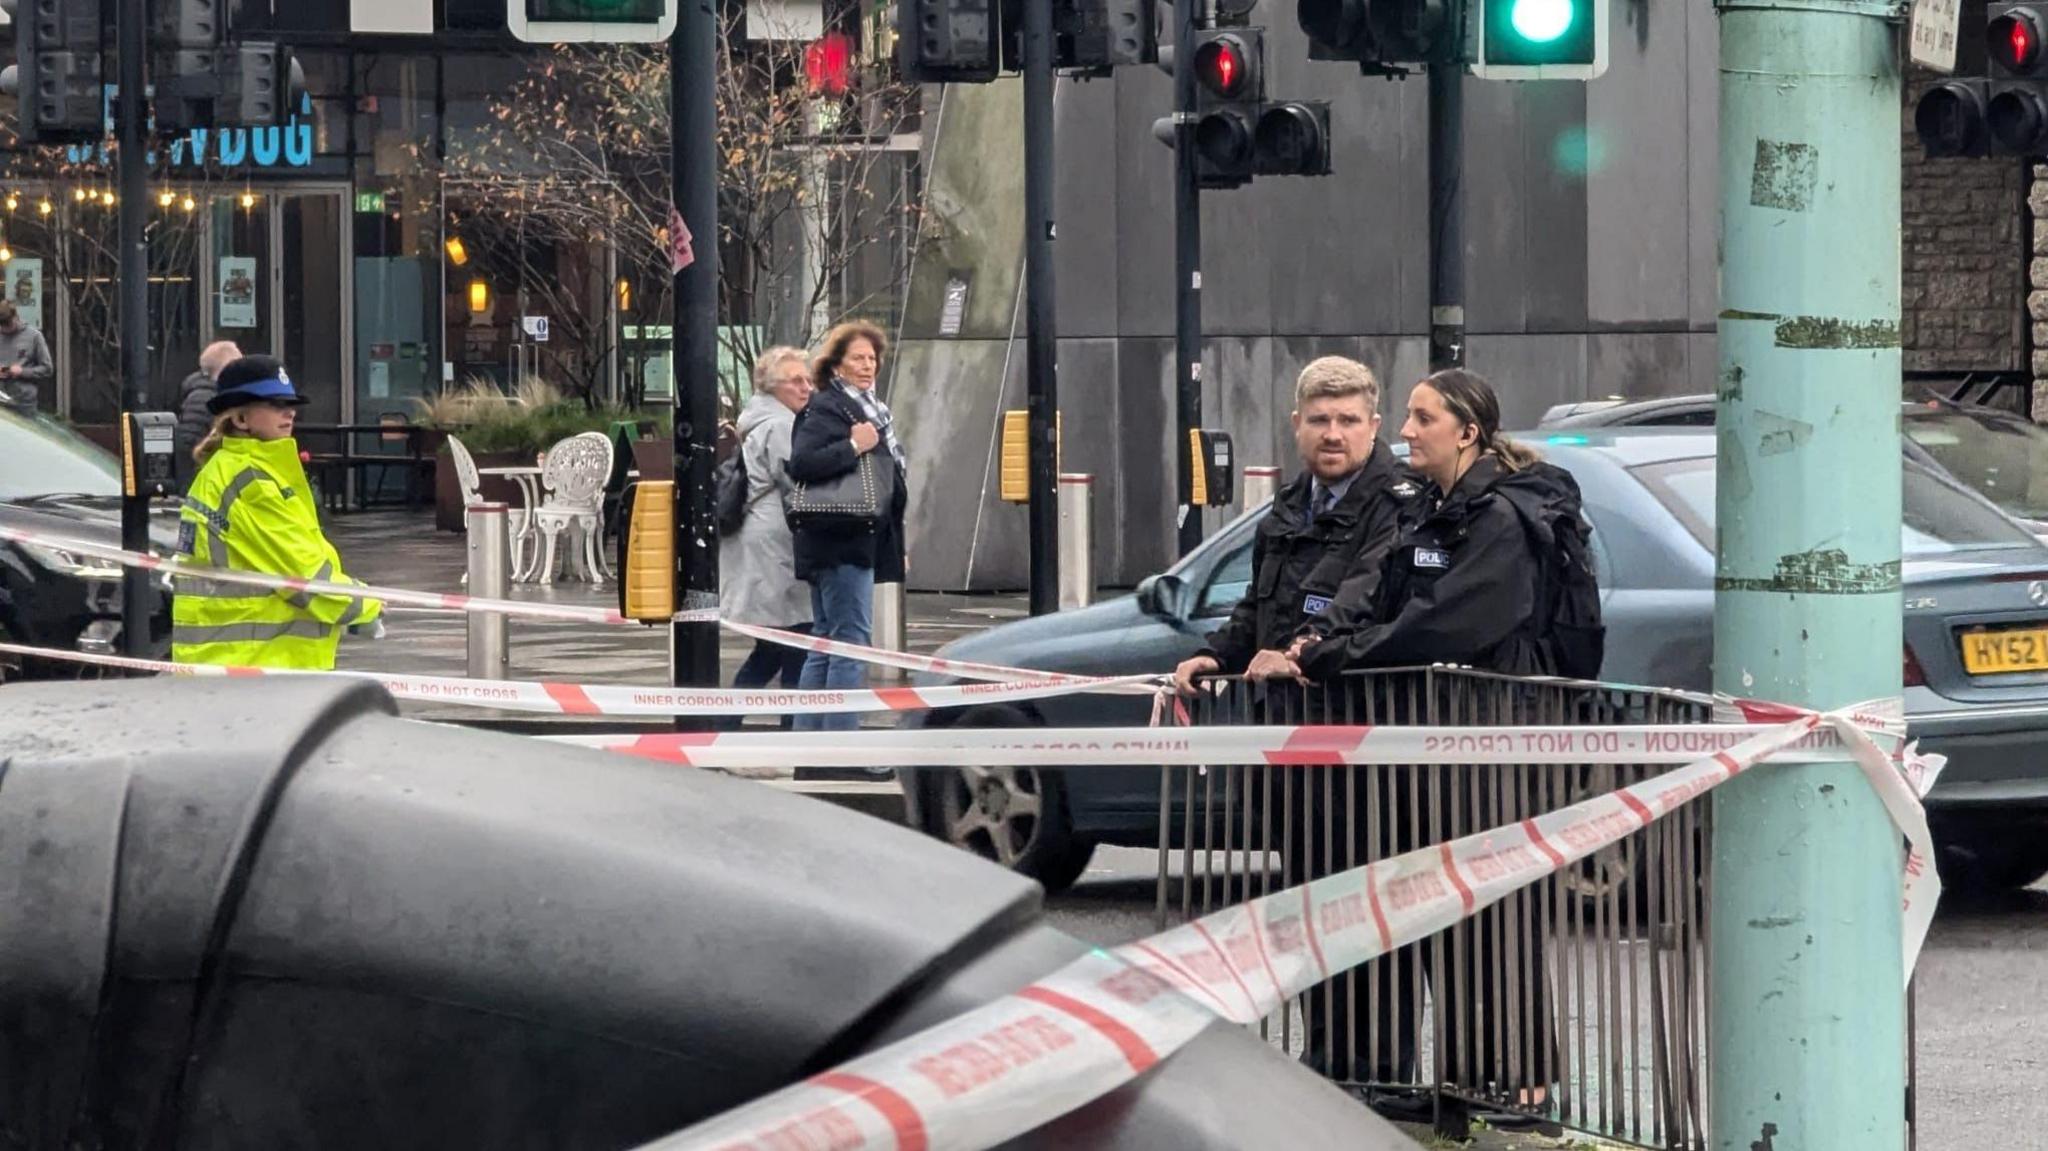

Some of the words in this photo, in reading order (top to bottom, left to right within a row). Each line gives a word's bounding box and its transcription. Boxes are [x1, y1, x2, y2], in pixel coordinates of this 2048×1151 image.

[1976, 637, 2038, 665] HY52
[421, 684, 439, 695] DO
[443, 687, 469, 697] NOT
[475, 688, 518, 699] CROSS
[633, 694, 674, 706] INNER
[677, 695, 733, 706] CORDON
[745, 697, 765, 706] DO
[768, 696, 795, 706] NOT
[799, 693, 845, 705] CROSS
